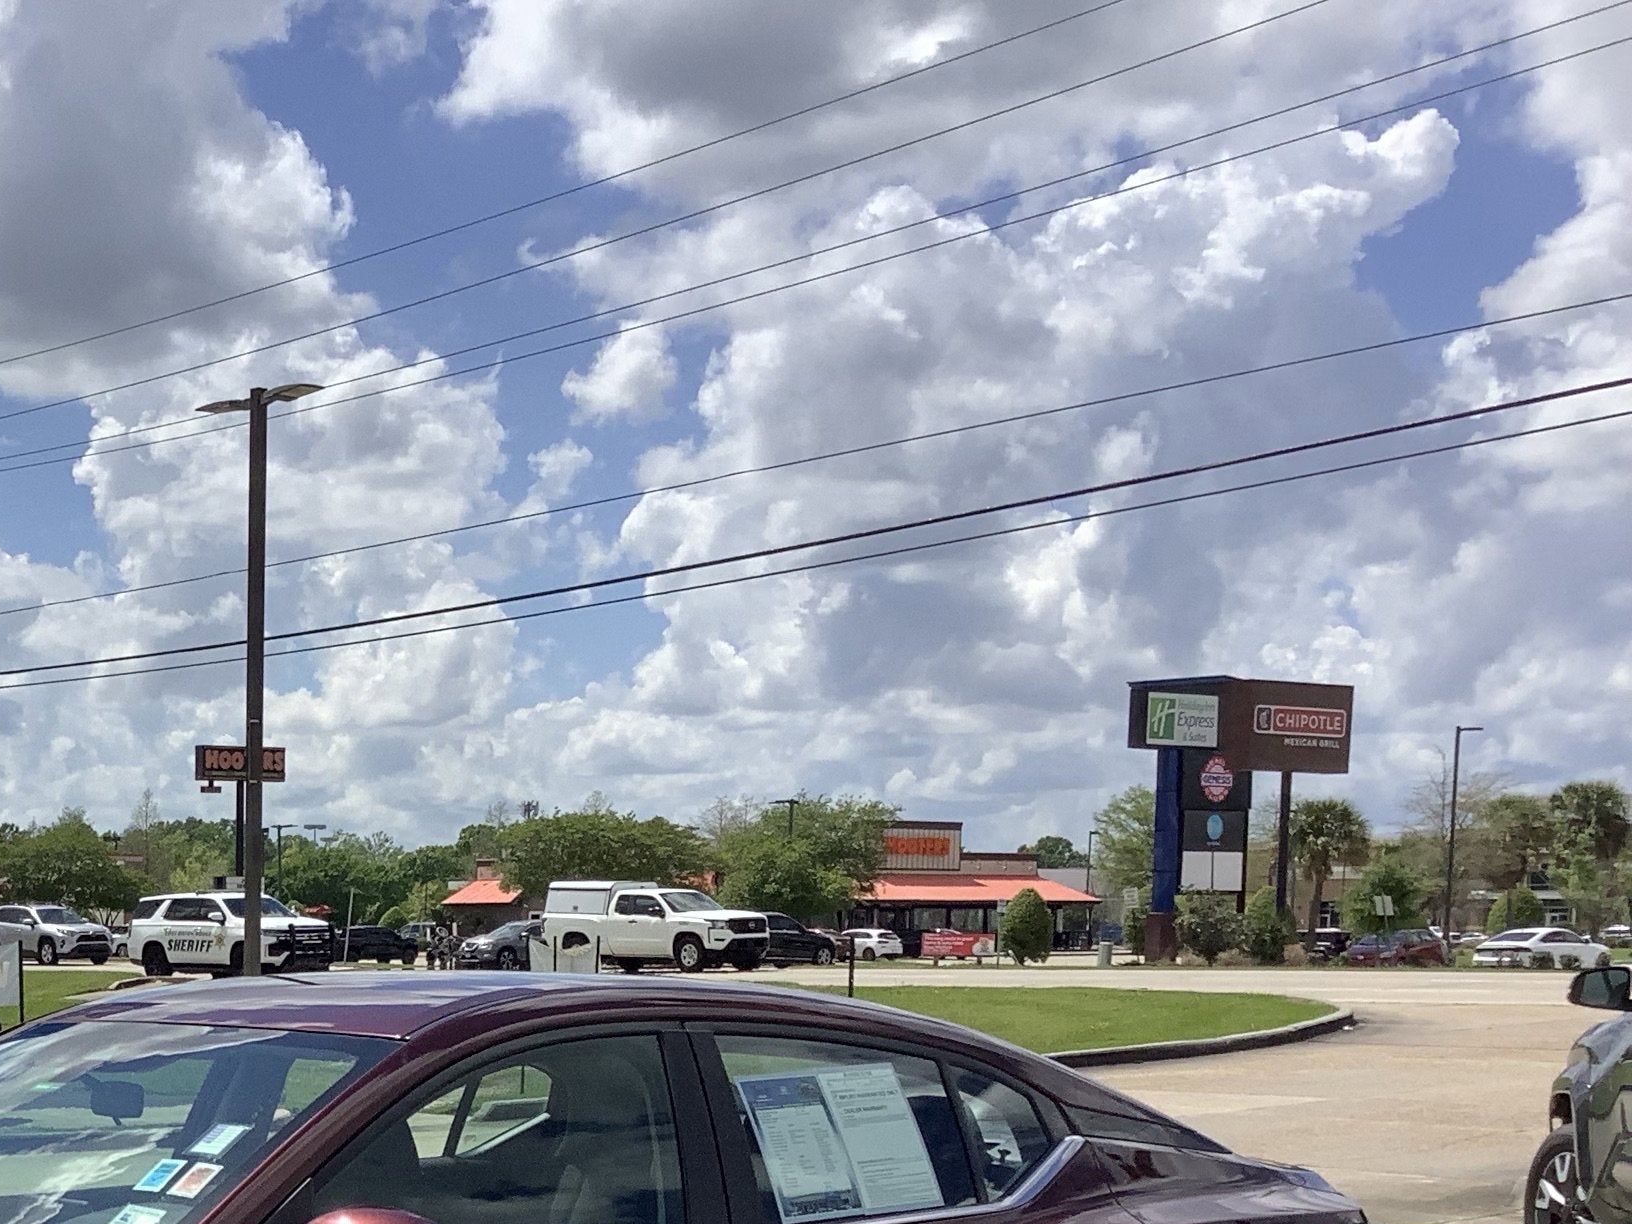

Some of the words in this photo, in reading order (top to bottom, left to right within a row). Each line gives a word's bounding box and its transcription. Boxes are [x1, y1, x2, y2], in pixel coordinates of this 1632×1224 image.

[1177, 710, 1215, 730] Express
[1275, 712, 1342, 731] CHIPOTLE
[1283, 737, 1318, 747] MEXICAN
[1318, 739, 1340, 749] GRILL
[204, 749, 284, 772] HOORS
[167, 938, 214, 952] SHERIFF
